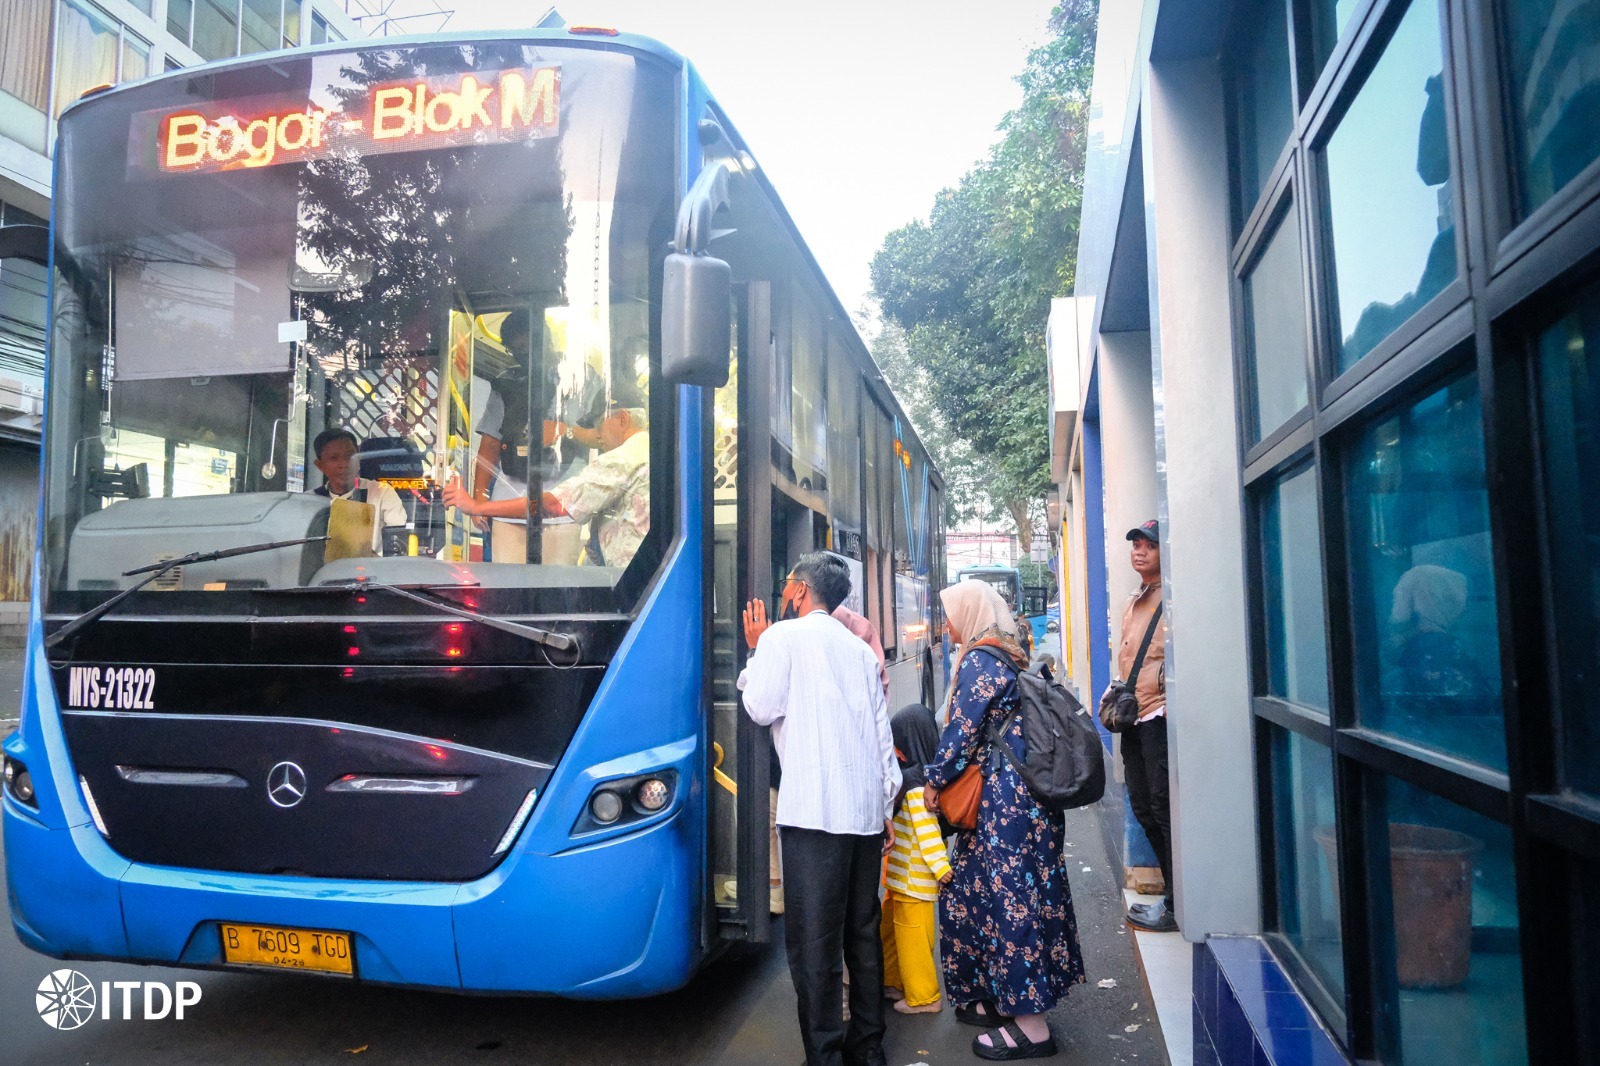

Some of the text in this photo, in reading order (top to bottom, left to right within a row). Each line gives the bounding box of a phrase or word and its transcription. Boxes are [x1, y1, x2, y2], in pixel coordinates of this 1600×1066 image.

[166, 109, 329, 168] Bogor
[372, 76, 494, 140] Blok
[500, 69, 556, 129] M
[69, 667, 155, 709] MYS-21322
[227, 927, 347, 959] B 7609 TGD
